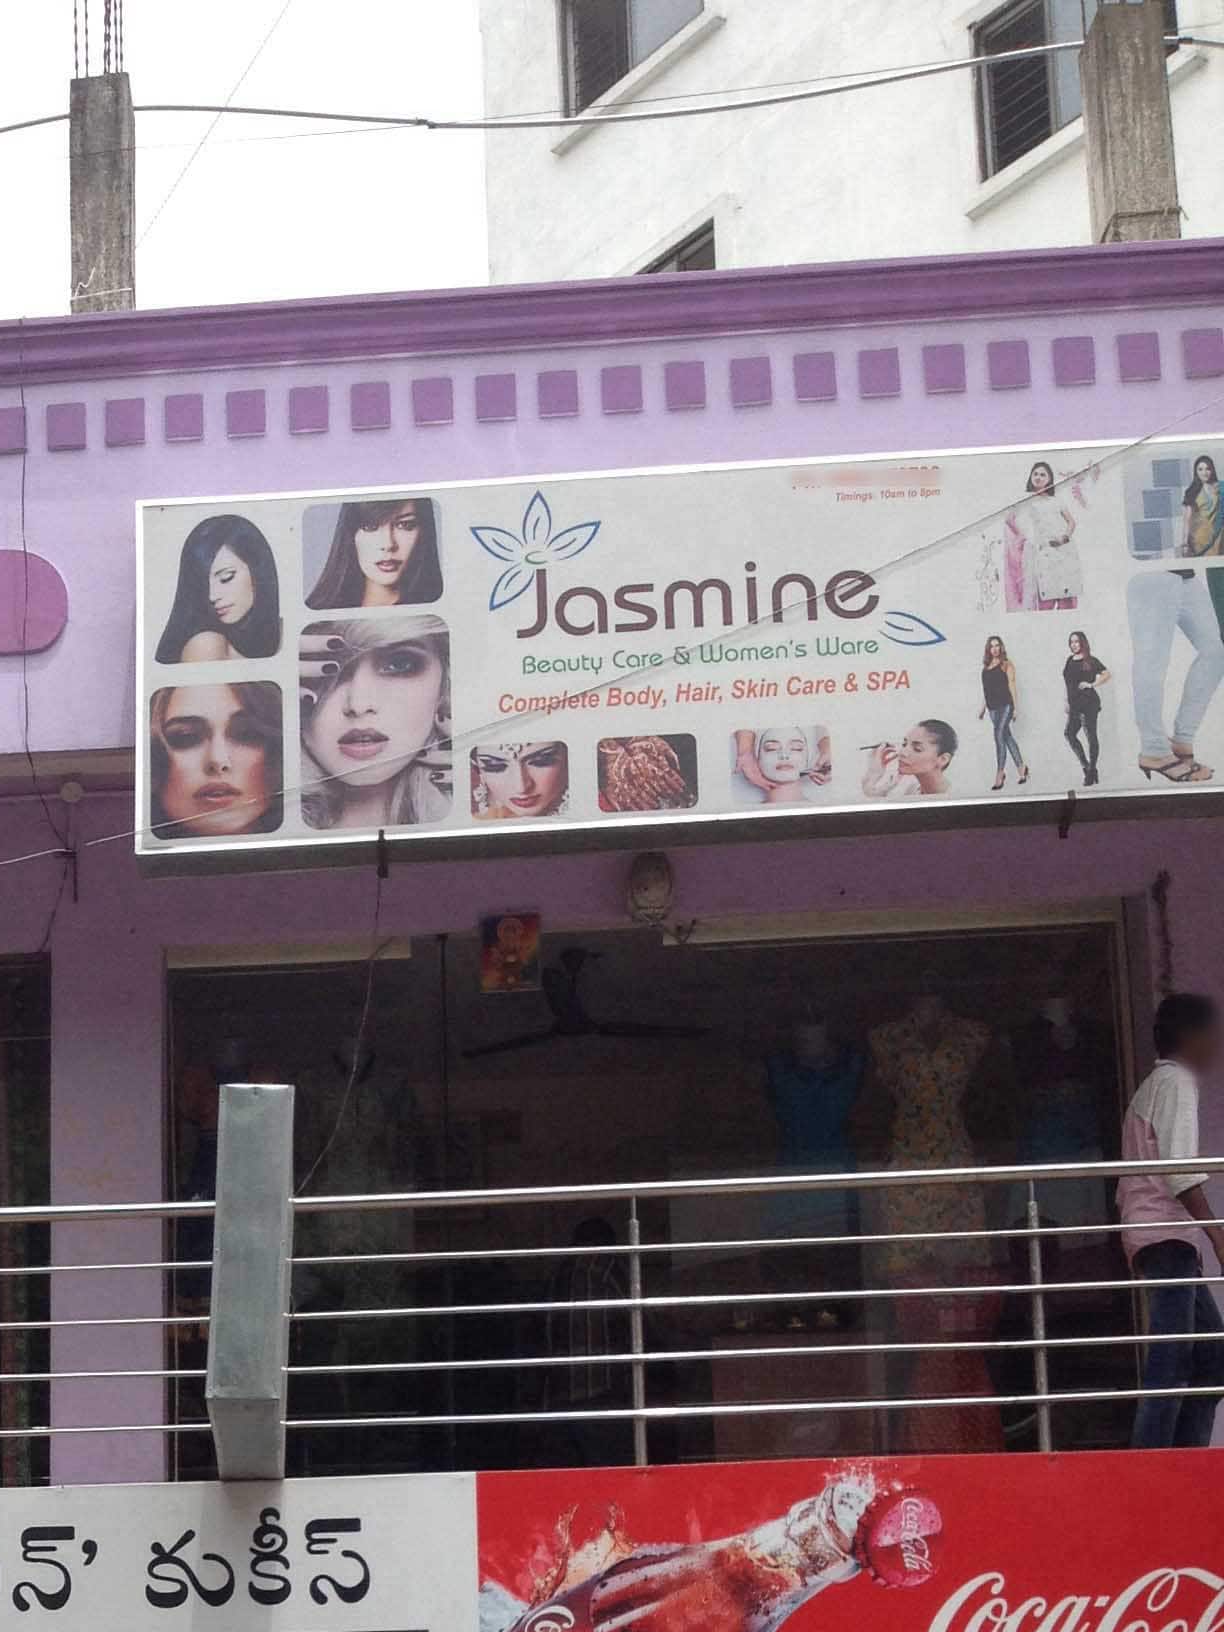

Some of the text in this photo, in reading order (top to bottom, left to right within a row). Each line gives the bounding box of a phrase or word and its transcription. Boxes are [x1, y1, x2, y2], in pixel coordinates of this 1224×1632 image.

[516, 560, 880, 639] Jasmine
[522, 655, 603, 676] Beauty
[612, 649, 664, 669] Care
[672, 646, 691, 666] &
[816, 637, 879, 657] Ware
[498, 670, 911, 716] Complete Body, Hair, Skin Care & SPA
[145, 1506, 371, 1610] కుకీస్
